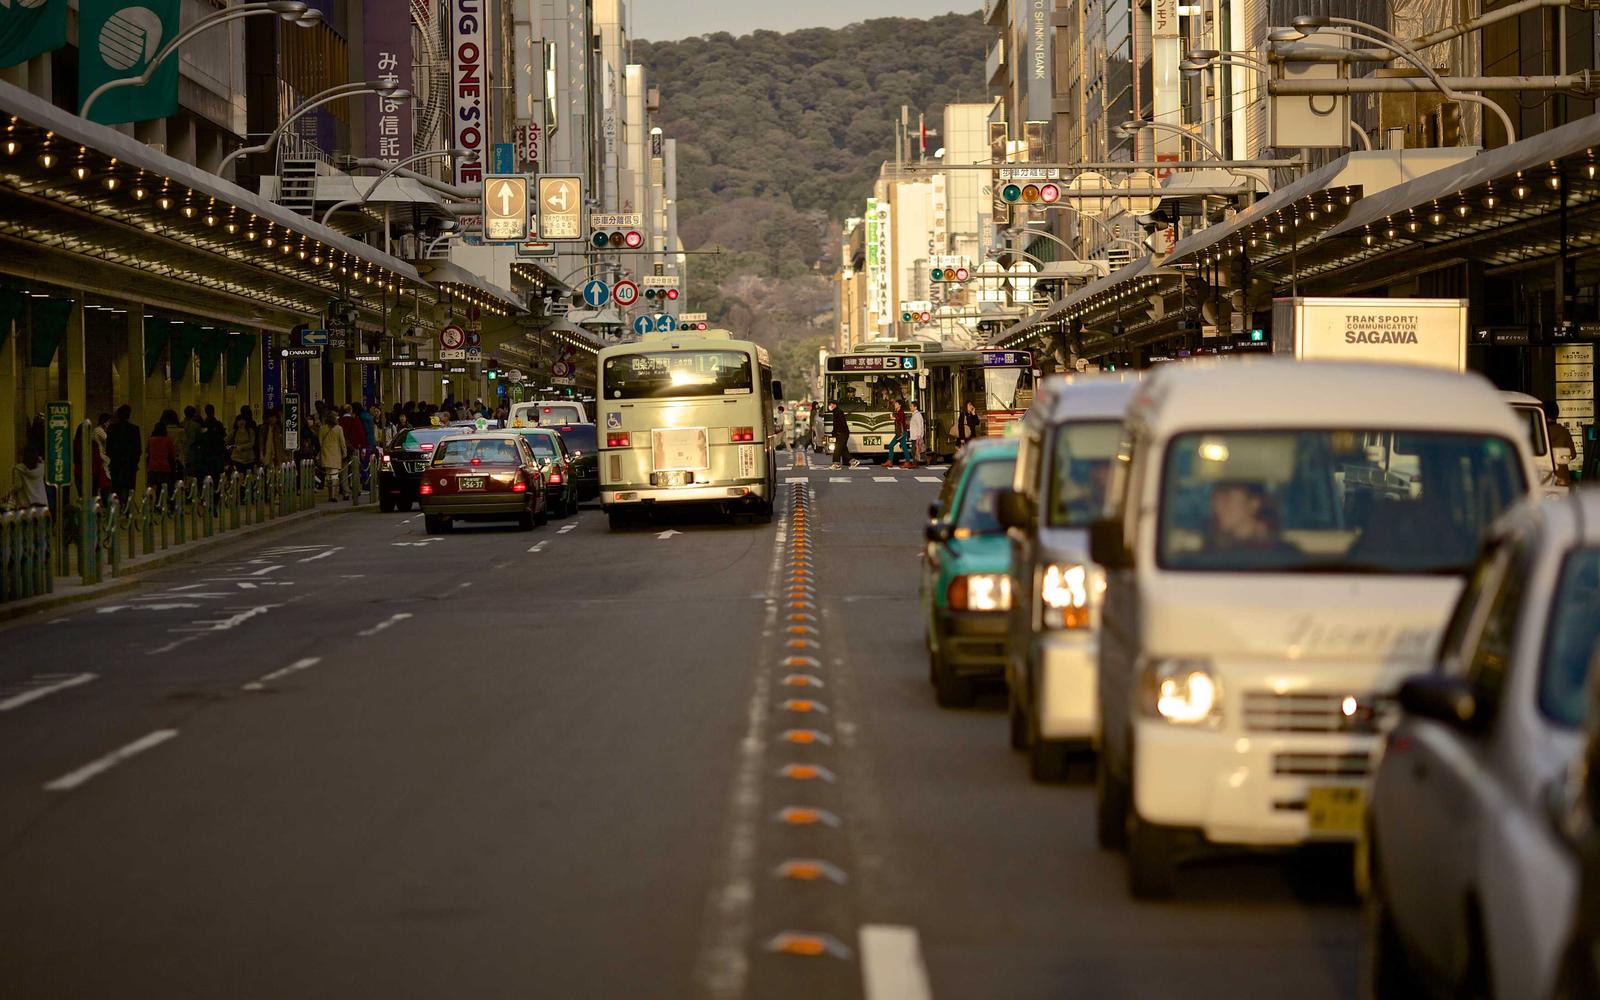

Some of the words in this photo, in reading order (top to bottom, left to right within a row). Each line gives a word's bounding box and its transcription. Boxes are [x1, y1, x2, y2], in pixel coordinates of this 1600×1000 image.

[1035, 11, 1044, 50] SHINKIN
[1036, 53, 1045, 79] BANK
[529, 122, 541, 163] doco
[593, 216, 640, 226] 歩車分離信号
[619, 288, 633, 299] 40
[1345, 331, 1418, 344] SAGAWA
[886, 358, 898, 368] 5
[50, 406, 69, 414] TAXI
